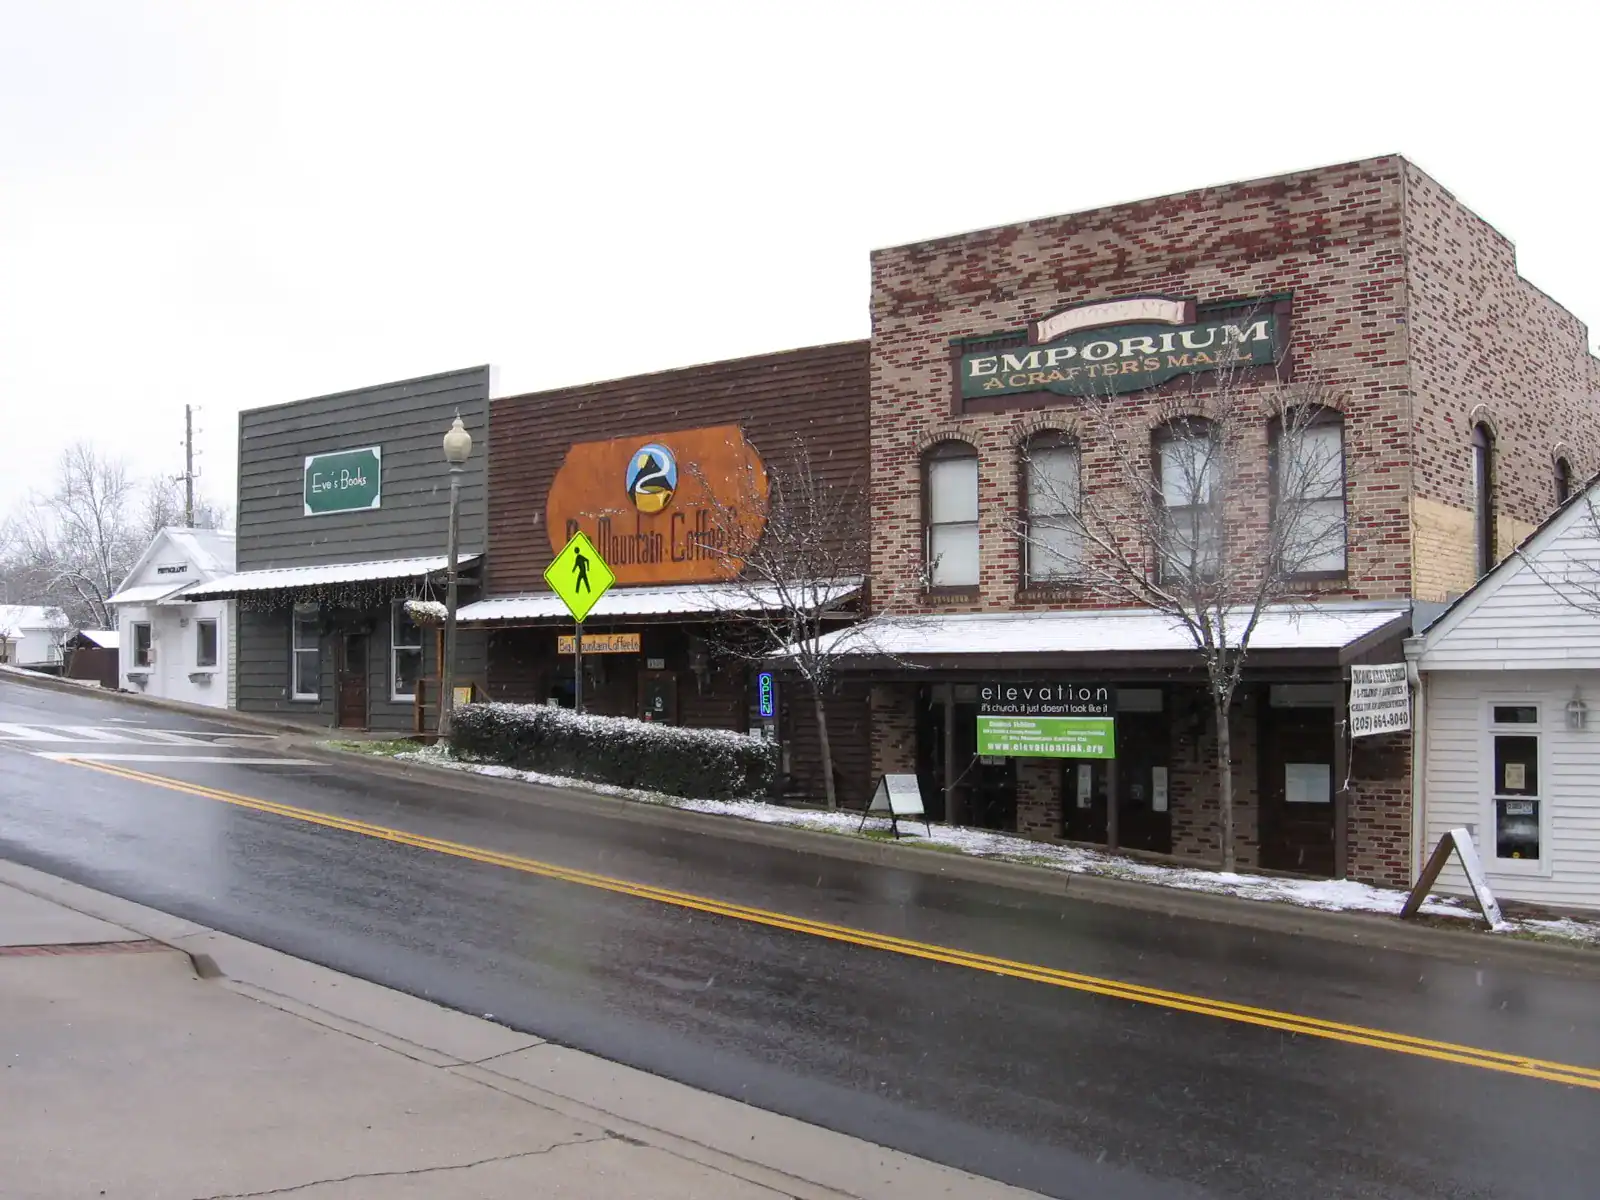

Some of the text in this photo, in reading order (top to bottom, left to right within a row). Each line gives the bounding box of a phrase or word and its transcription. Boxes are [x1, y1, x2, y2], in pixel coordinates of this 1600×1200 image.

[969, 320, 1269, 377] EMPORIUM
[983, 349, 1253, 391] A CRAFTER'S MAL
[312, 466, 367, 493] Eve's Books
[598, 514, 663, 566] Mountain
[761, 676, 771, 714] OPEN
[981, 684, 1108, 700] elevation
[981, 703, 991, 712] it's
[1026, 704, 1039, 715] just
[1041, 703, 1069, 713] doesn't
[1070, 703, 1087, 713] look
[1088, 703, 1102, 713] like
[1103, 703, 1108, 713] it
[1352, 715, 1373, 734] (205)
